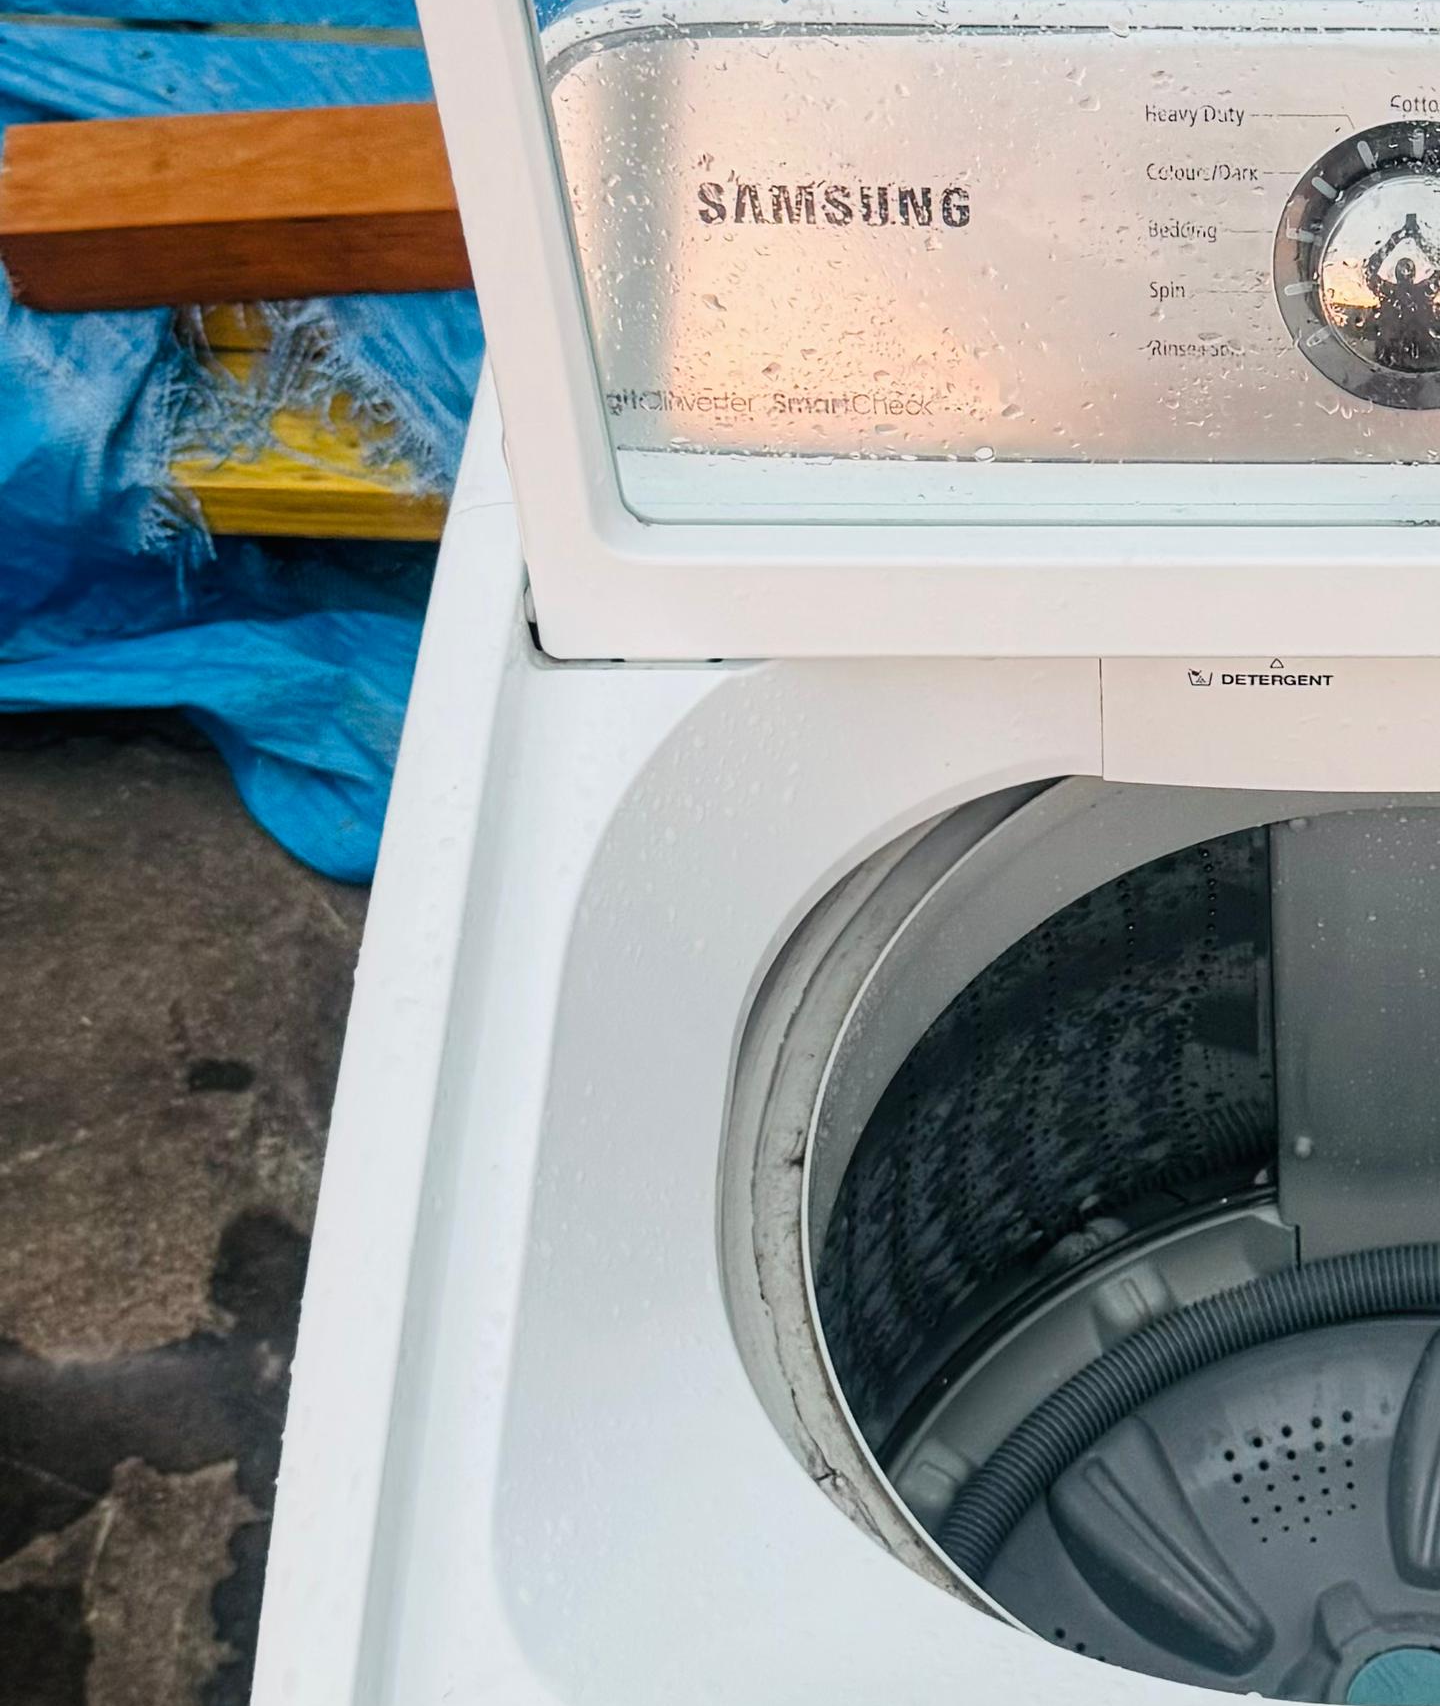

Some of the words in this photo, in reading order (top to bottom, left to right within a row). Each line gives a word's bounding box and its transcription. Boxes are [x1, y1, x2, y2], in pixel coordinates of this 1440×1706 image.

[1145, 105, 1198, 127] Heavy
[1200, 105, 1245, 126] Duty
[698, 182, 970, 228] SAMSUNG
[1149, 220, 1217, 243] Bedding
[1149, 281, 1185, 302] Spin
[1221, 674, 1334, 686] DETERGENT
